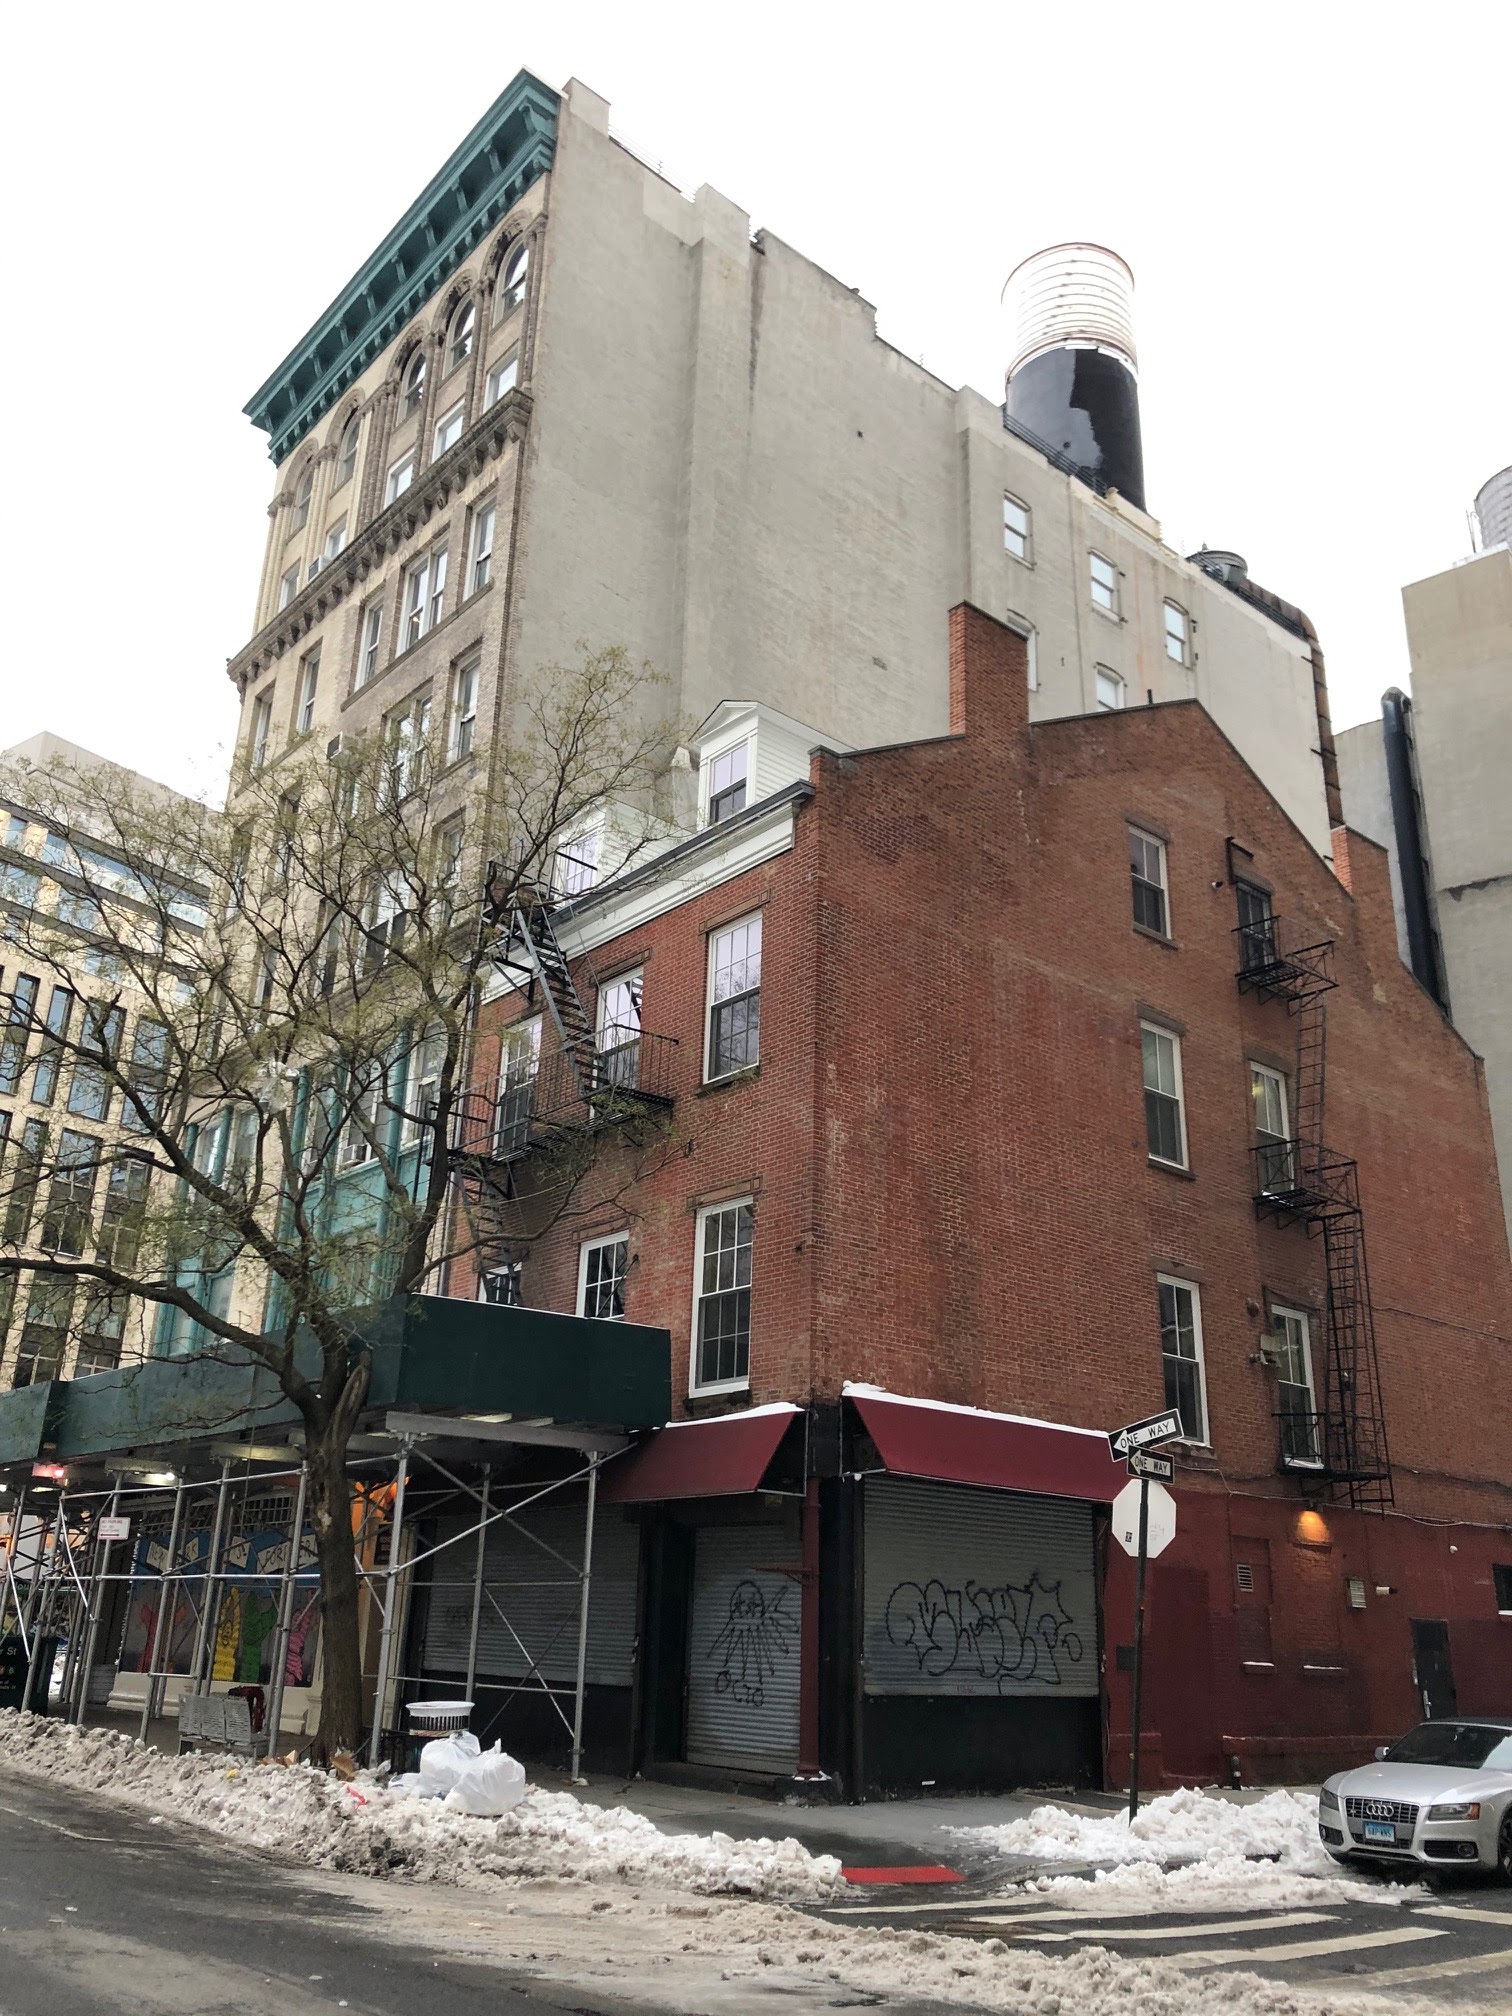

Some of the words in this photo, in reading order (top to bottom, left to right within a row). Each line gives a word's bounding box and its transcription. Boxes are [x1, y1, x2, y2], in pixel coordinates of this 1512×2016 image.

[1120, 1433, 1140, 1449] ONE
[1147, 1421, 1170, 1438] WAY
[1134, 1455, 1147, 1469] ONE
[1153, 1461, 1168, 1474] WAY
